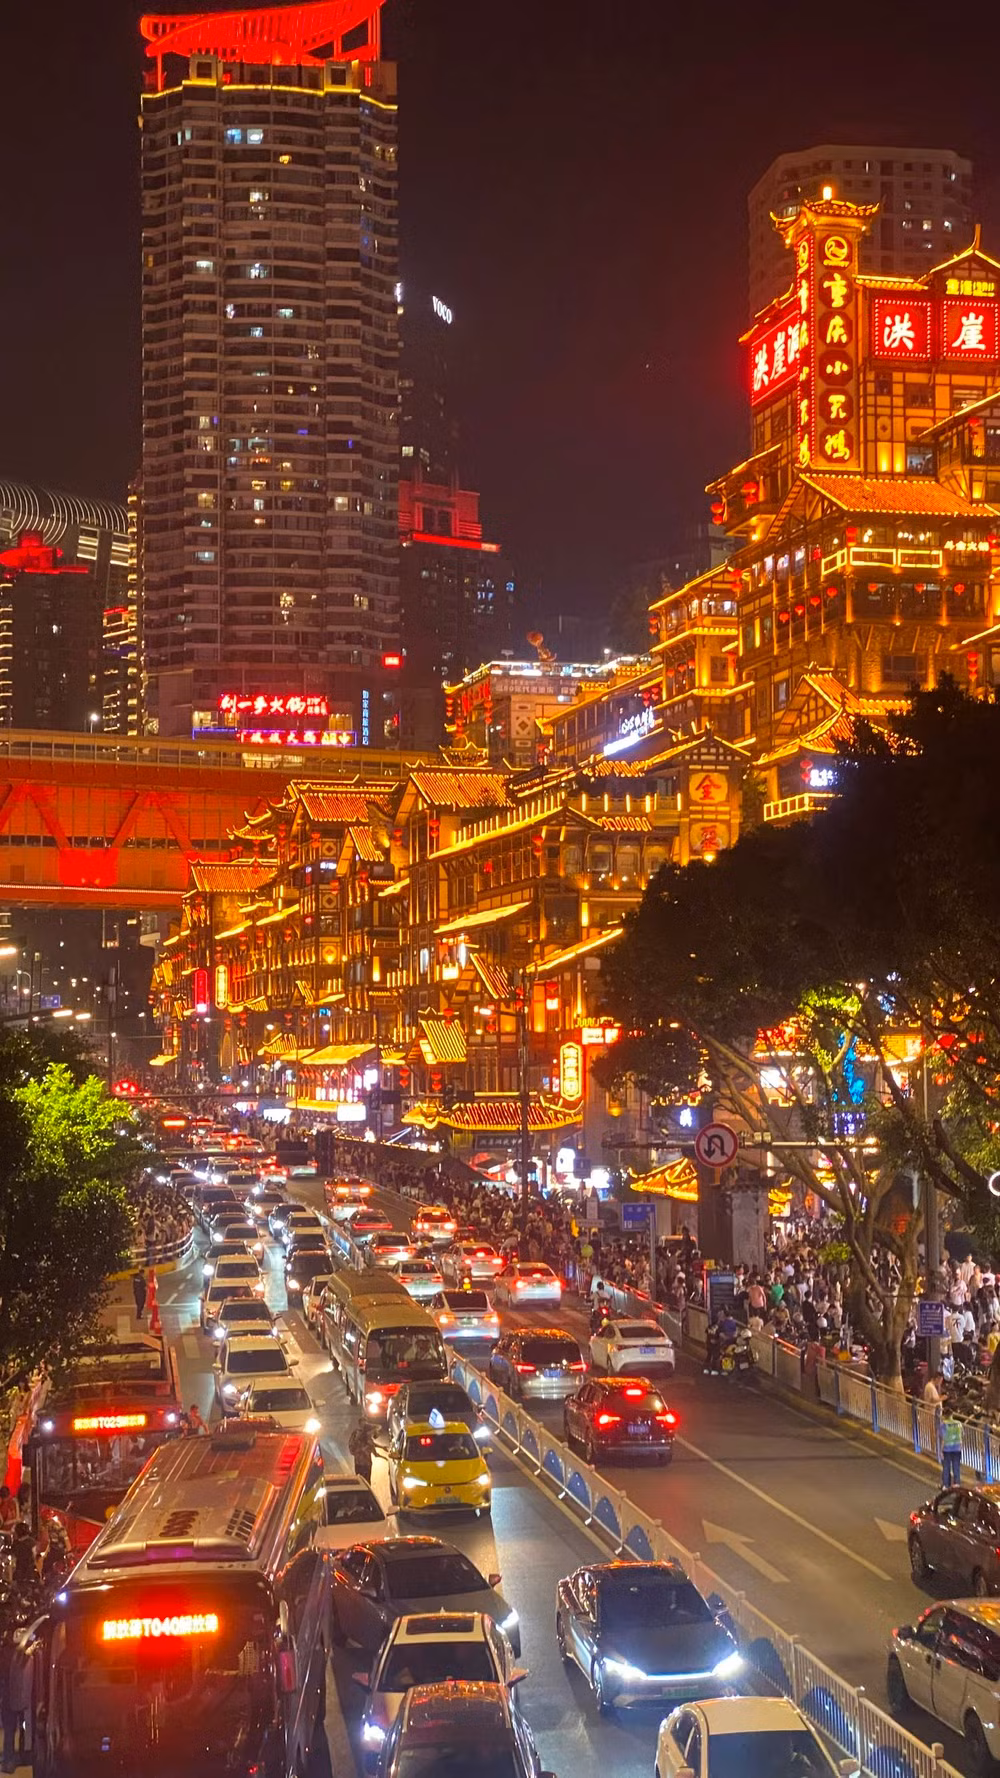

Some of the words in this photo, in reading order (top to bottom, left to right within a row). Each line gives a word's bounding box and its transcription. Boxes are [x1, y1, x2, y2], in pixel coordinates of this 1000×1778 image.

[823, 272, 849, 460] 重庆小天鹅
[221, 695, 306, 715] 刘一手火锅
